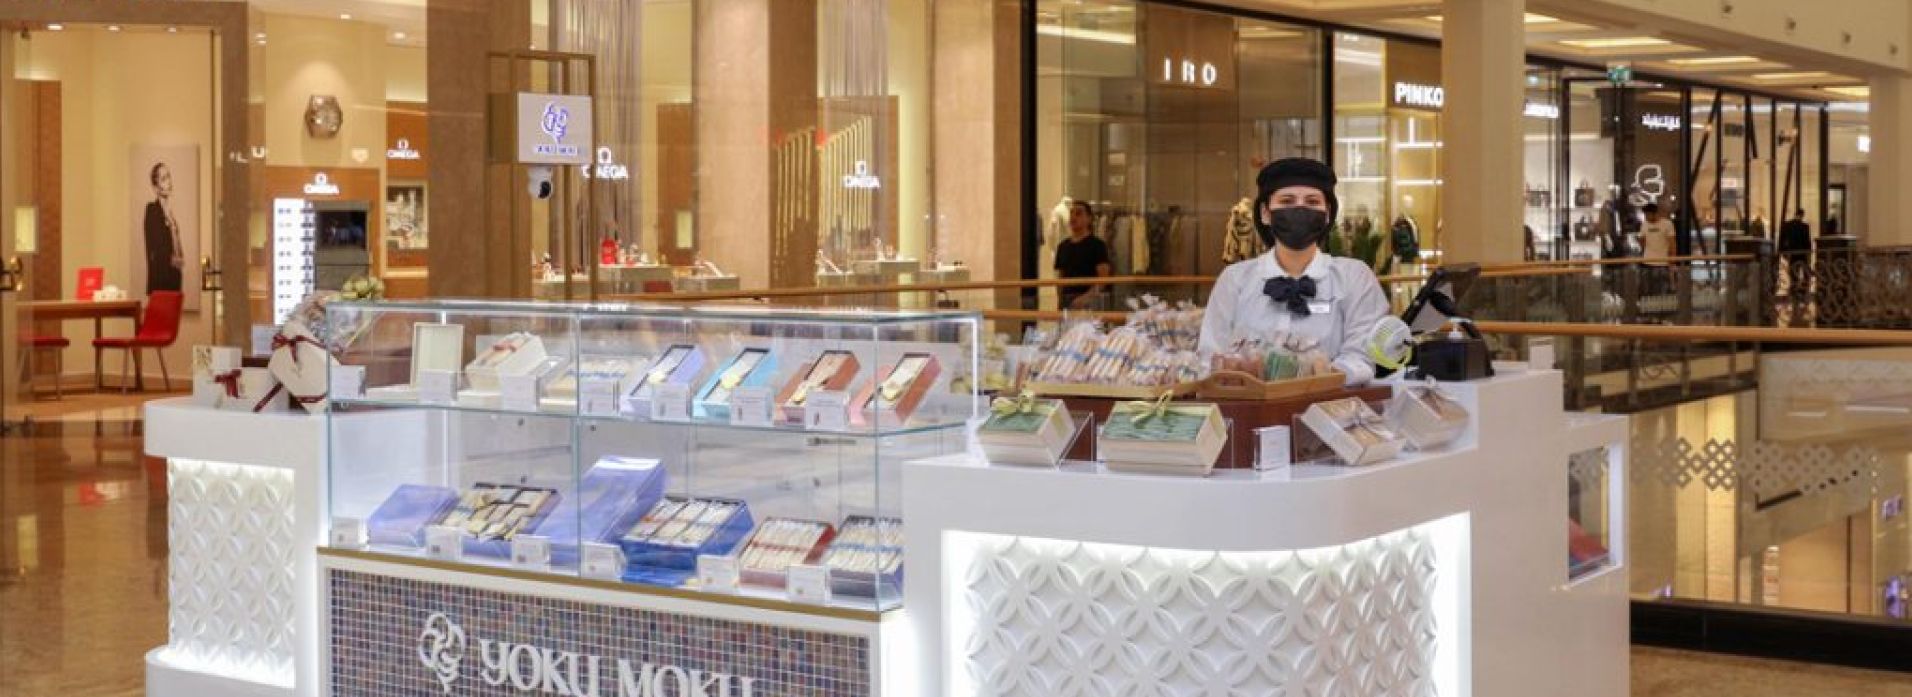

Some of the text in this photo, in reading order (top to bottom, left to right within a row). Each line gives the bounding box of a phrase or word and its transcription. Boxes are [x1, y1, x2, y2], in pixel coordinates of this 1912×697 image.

[1164, 57, 1217, 86] IRO
[1395, 81, 1444, 107] PINKO
[479, 639, 601, 697] YOKU
